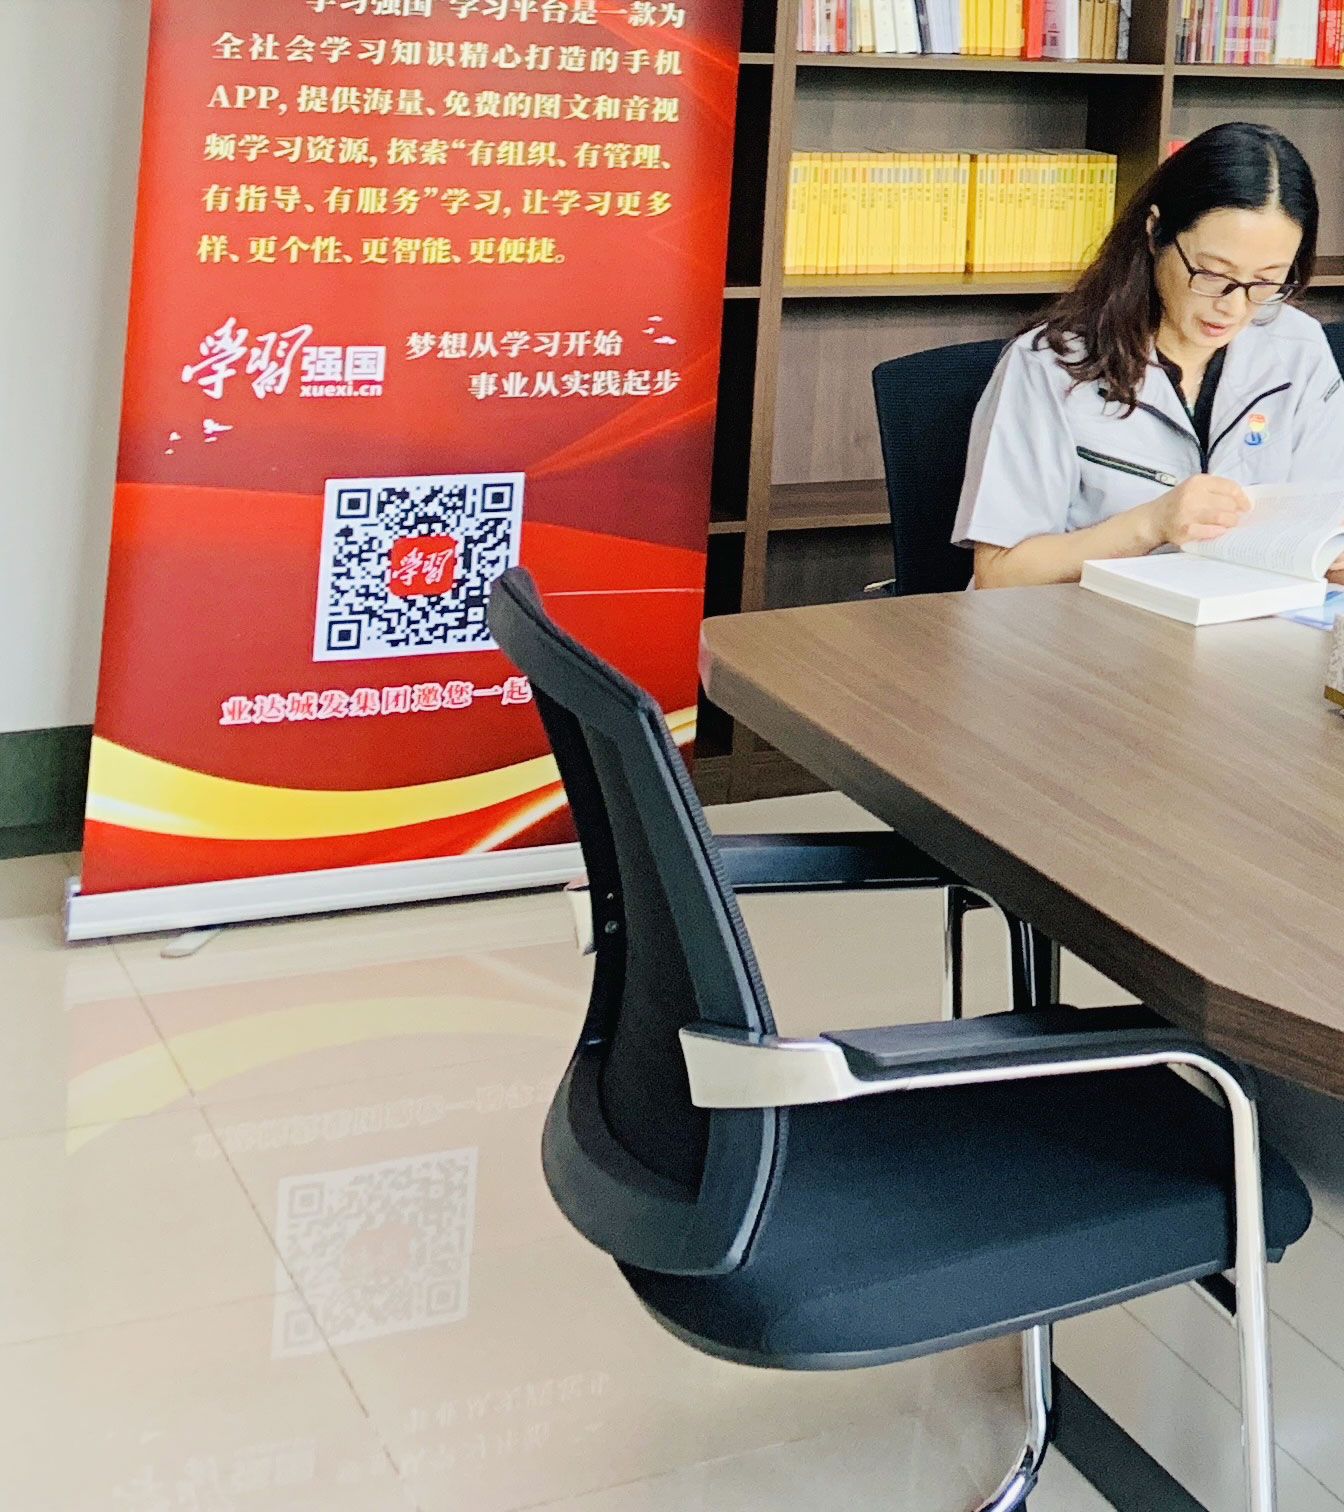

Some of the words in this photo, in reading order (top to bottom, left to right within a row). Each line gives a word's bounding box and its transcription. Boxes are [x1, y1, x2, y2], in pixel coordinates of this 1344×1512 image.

[211, 31, 683, 77] 全社会学习知识精心打造的手机
[196, 234, 568, 265] 样、更个性、更智能、更便捷。
[404, 330, 623, 360] 梦想从学习开始
[299, 380, 383, 399] xuexi.cn
[467, 368, 682, 400] 事业从实践起步
